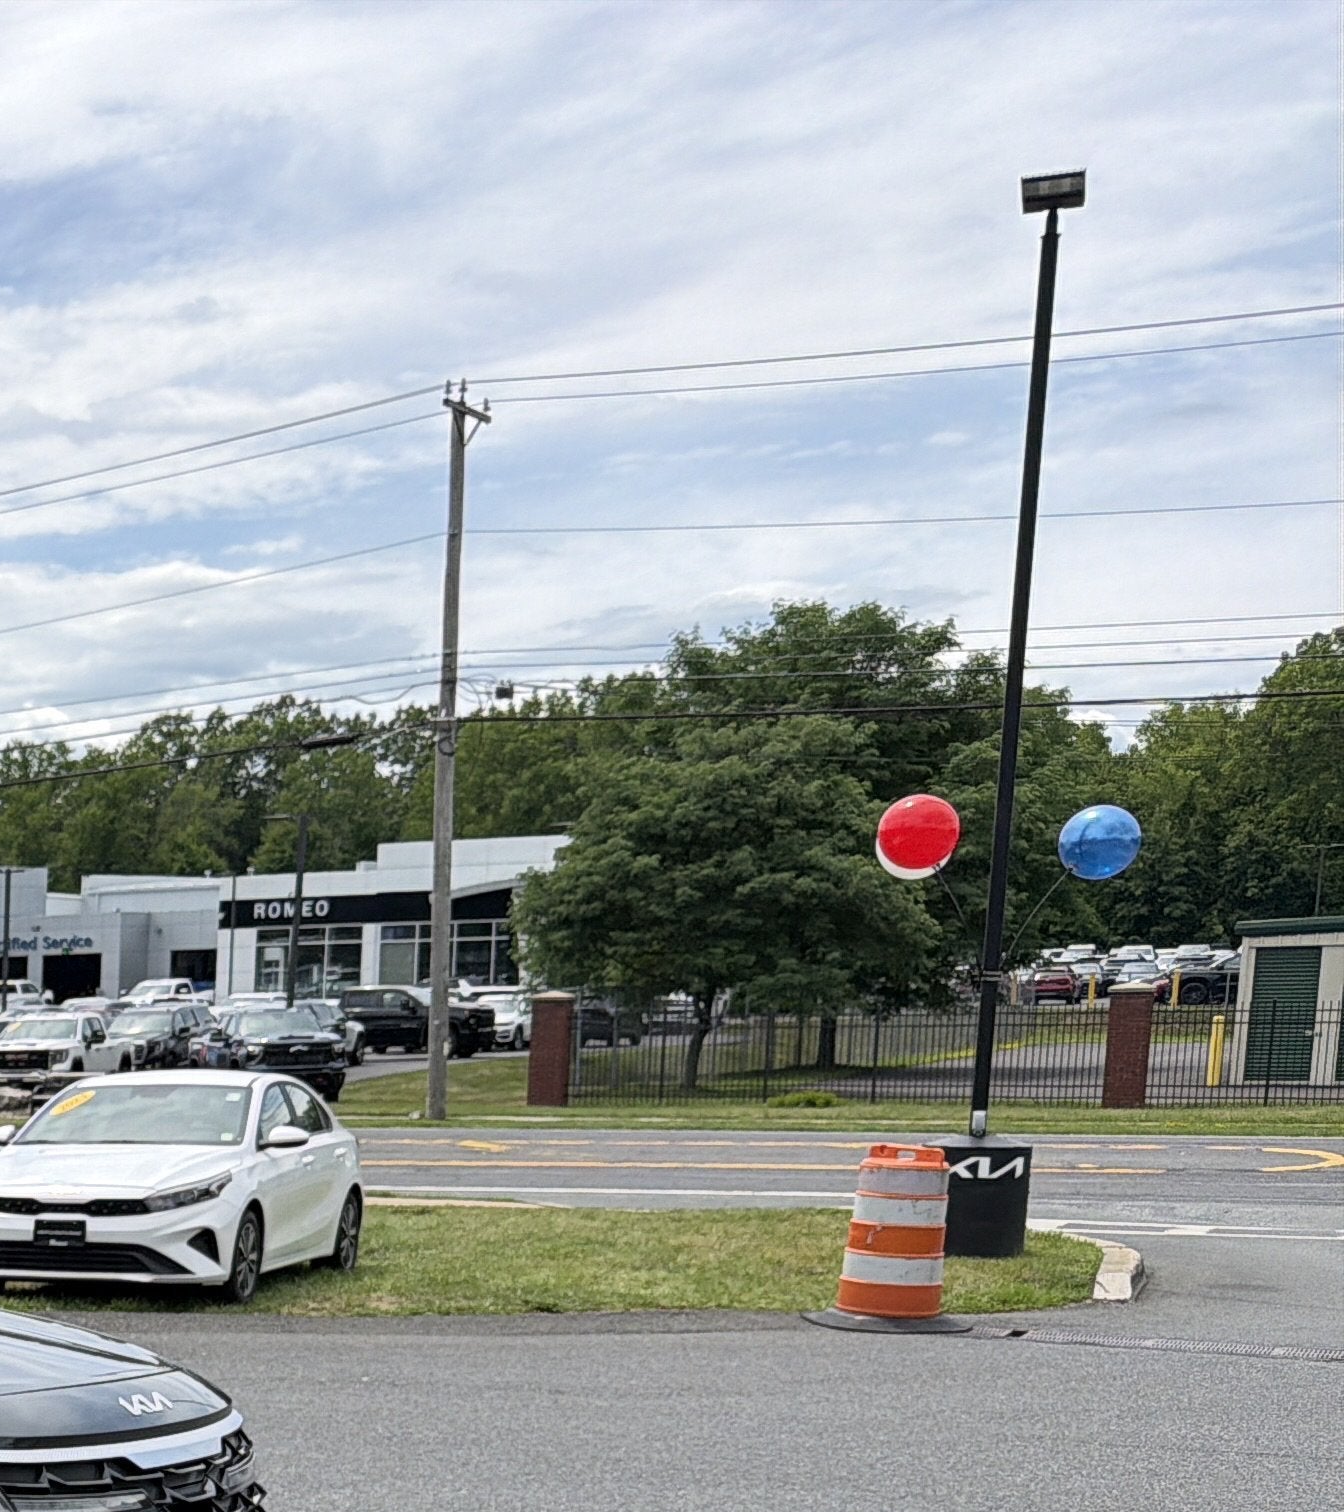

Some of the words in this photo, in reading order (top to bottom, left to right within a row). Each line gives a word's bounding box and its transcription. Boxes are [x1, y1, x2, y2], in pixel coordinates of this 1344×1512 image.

[253, 899, 330, 919] ROMEO
[42, 935, 93, 951] Service
[948, 1156, 1025, 1179] KIA
[118, 1391, 174, 1416] KIA
